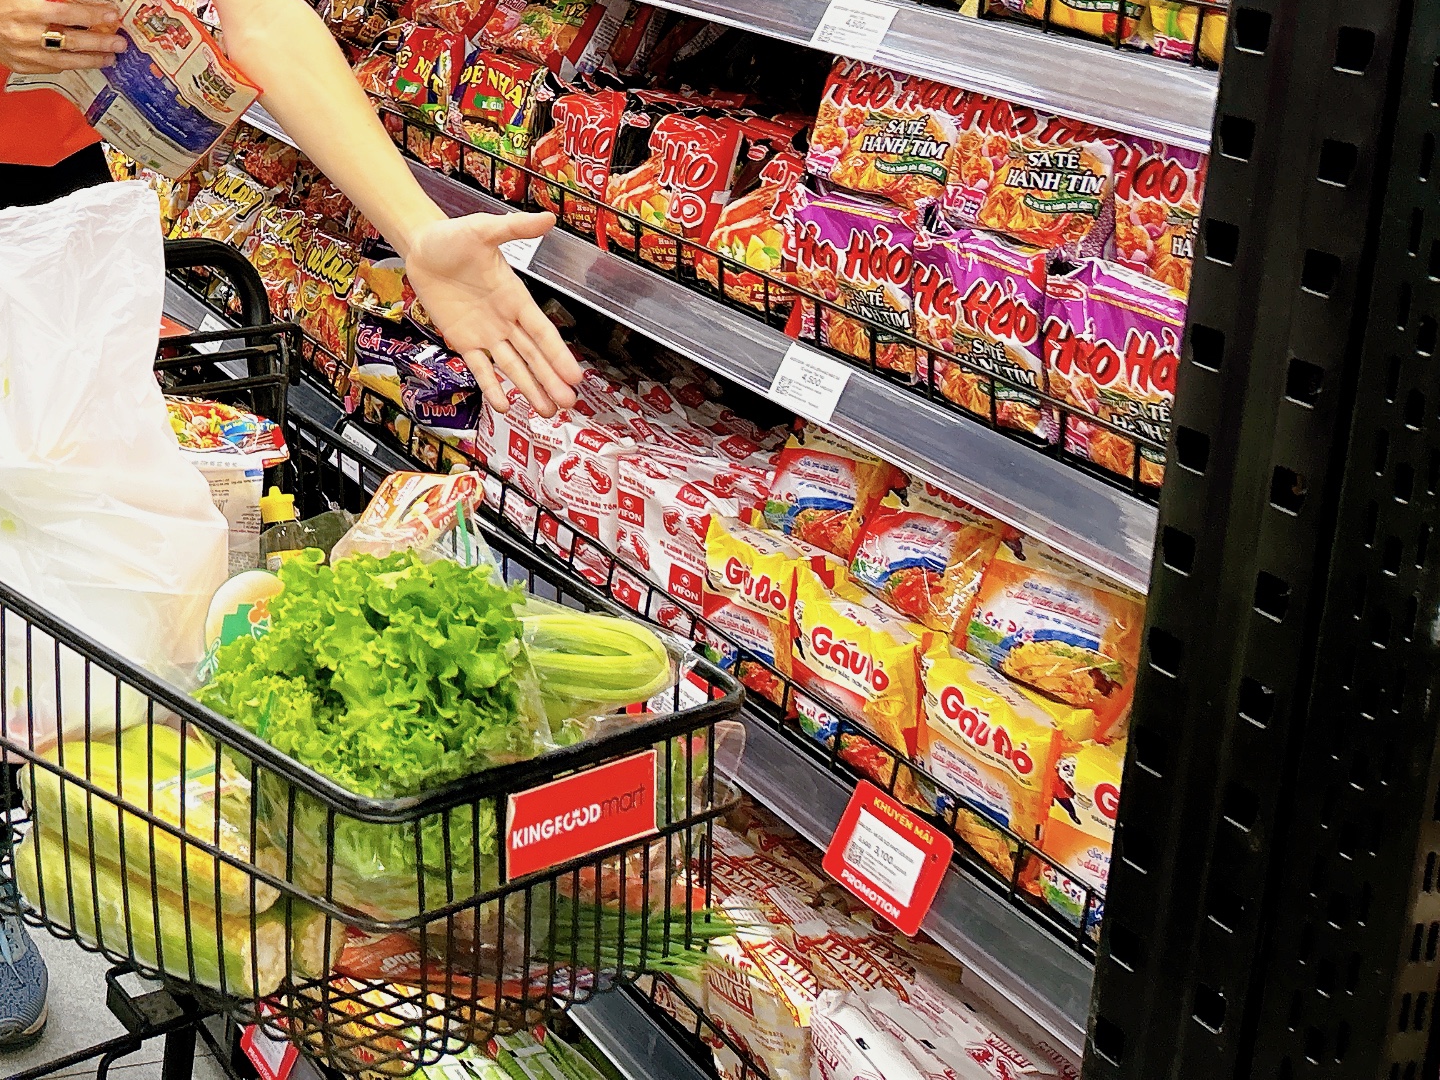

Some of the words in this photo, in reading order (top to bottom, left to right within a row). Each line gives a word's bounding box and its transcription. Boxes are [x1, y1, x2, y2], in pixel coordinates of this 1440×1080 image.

[461, 60, 485, 87] ĐỆ
[861, 131, 908, 155] HÀNH
[909, 136, 950, 160] TÍM
[886, 119, 906, 135] SA
[906, 114, 931, 136] TẾ
[1006, 164, 1063, 191] HÀNH
[1065, 167, 1107, 195] TÍM
[1028, 151, 1055, 169] SA
[1055, 145, 1081, 170] TẾ
[1115, 142, 1188, 205] Hảo
[844, 225, 913, 289] Hảo
[963, 274, 1039, 346] Hảo
[1043, 316, 1121, 389] Hảo
[1124, 327, 1178, 394] Hả
[671, 582, 700, 601] VIFON
[811, 625, 864, 677] Gấu
[941, 684, 990, 747] Gấu
[992, 730, 1033, 776] Đỏ
[873, 796, 914, 831] KHUYẾN
[913, 824, 934, 846] MÃI
[841, 869, 901, 919] PROMOTION
